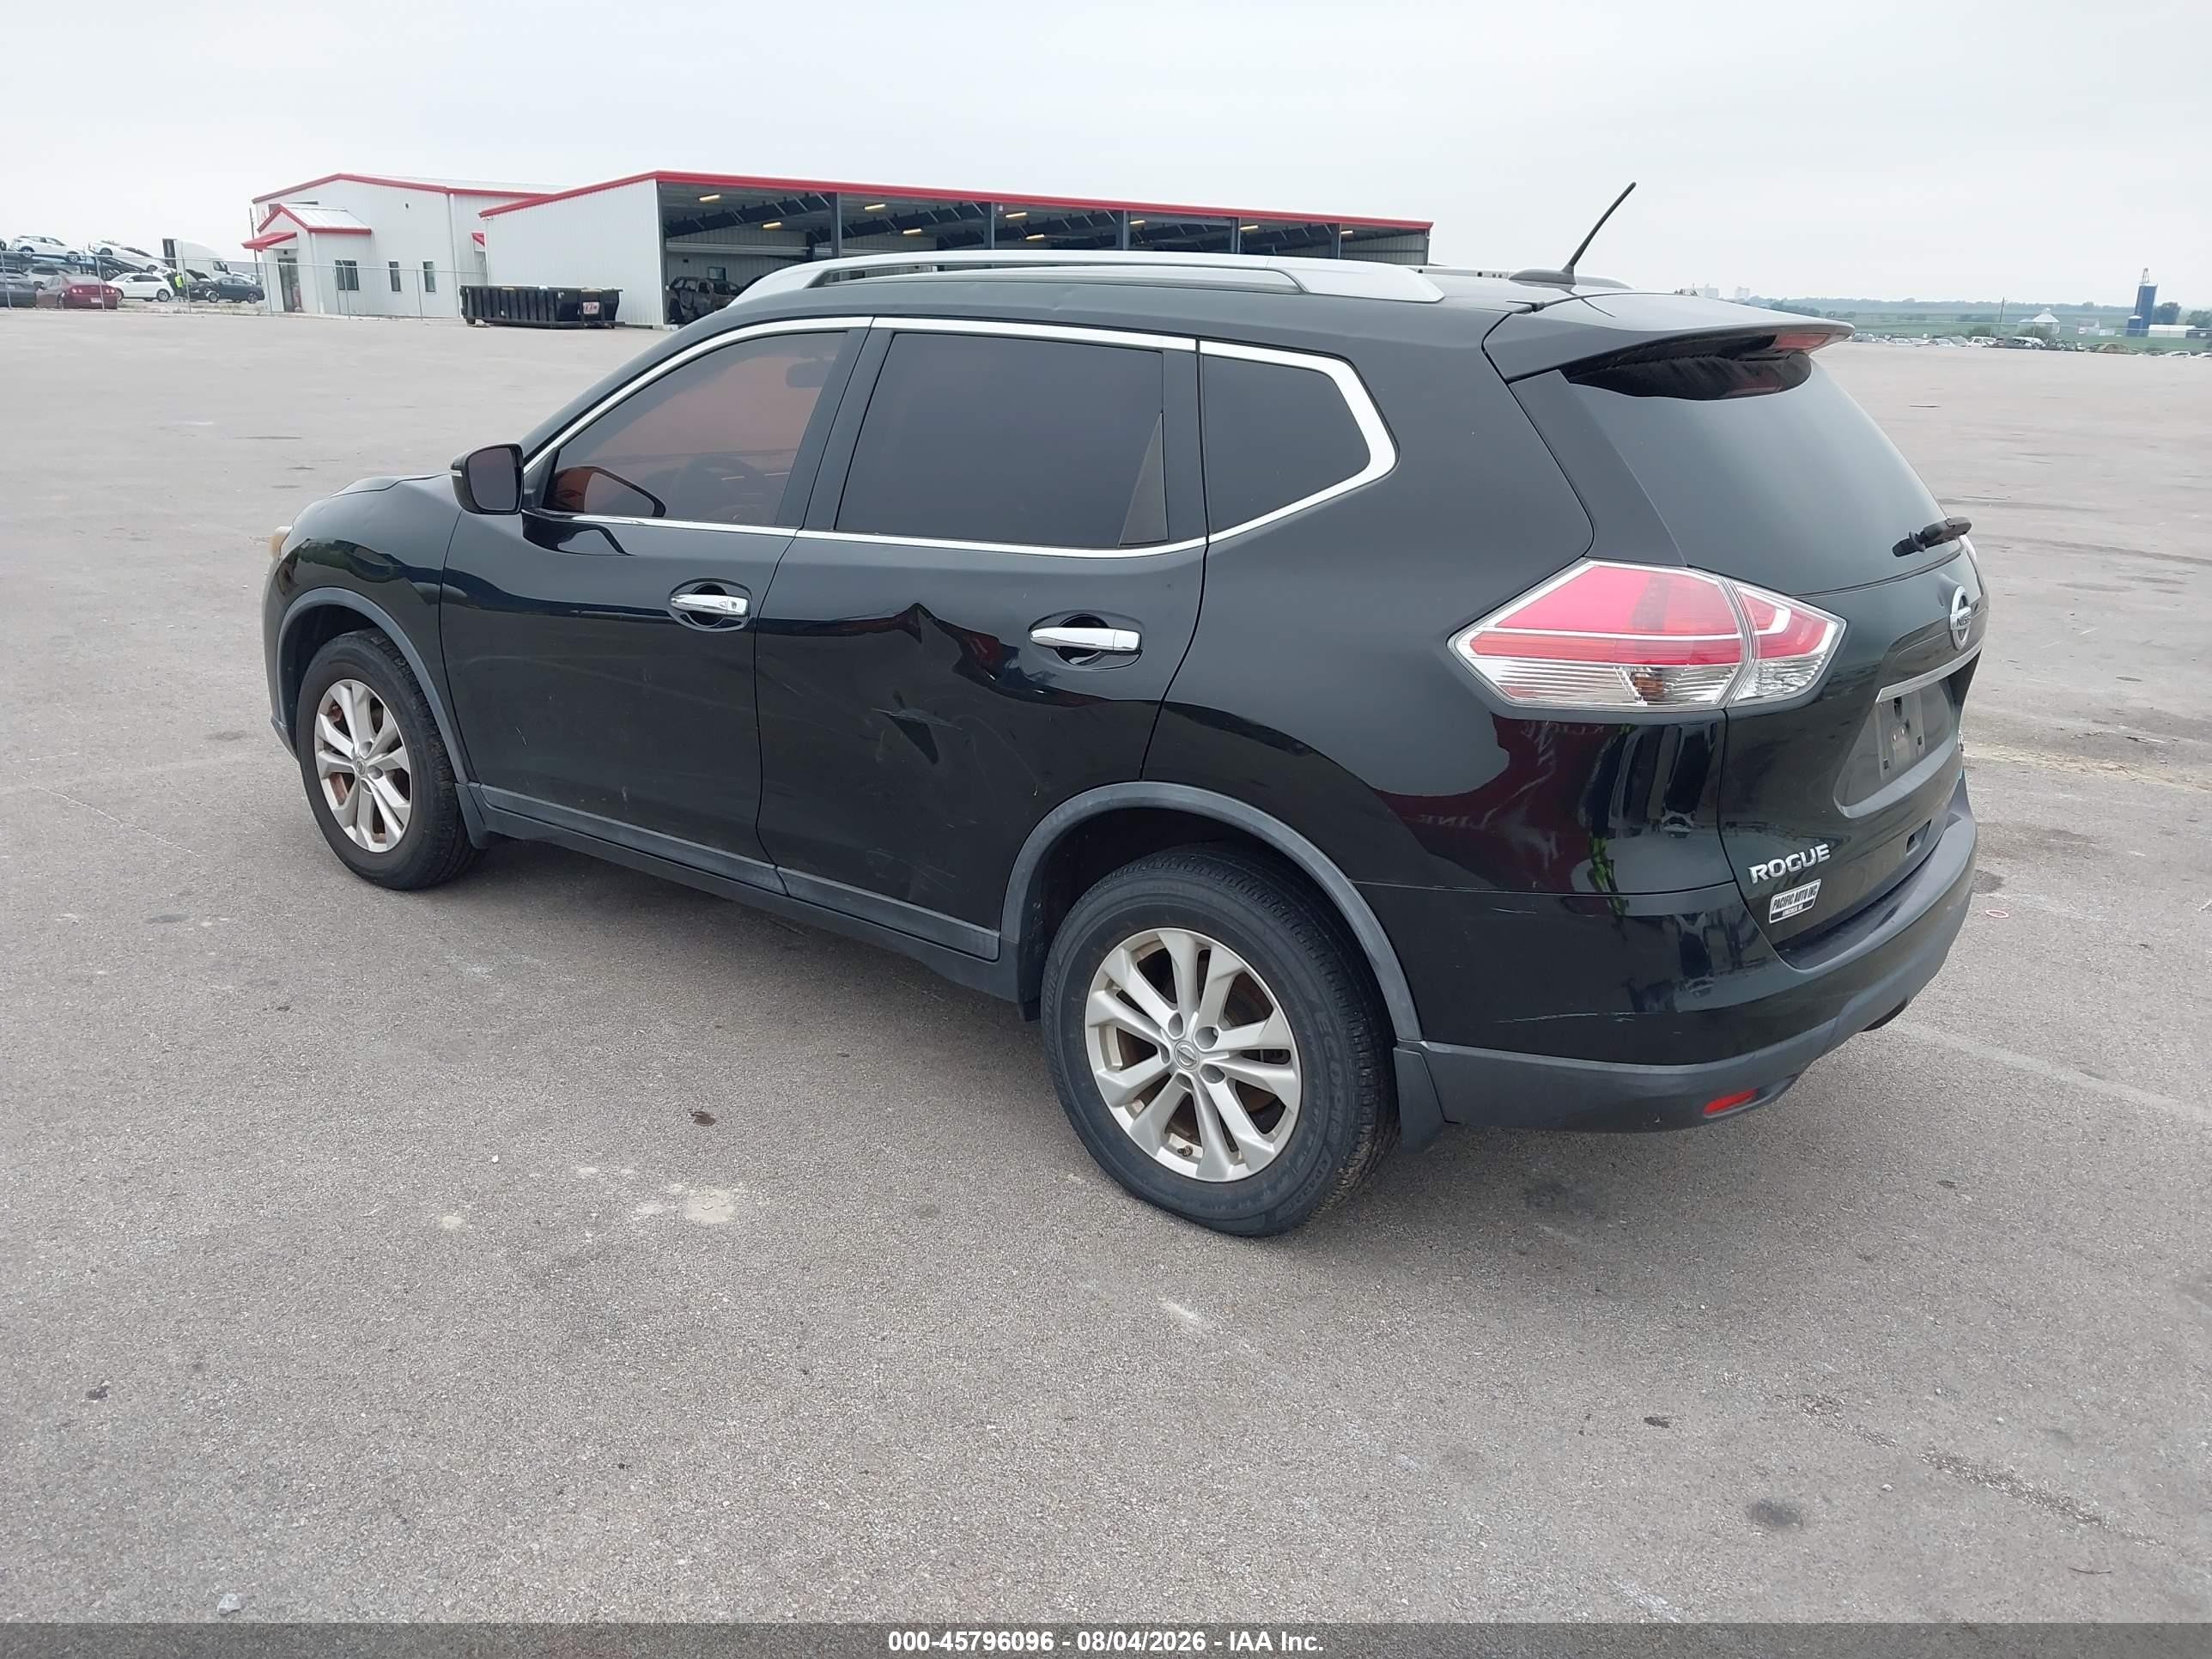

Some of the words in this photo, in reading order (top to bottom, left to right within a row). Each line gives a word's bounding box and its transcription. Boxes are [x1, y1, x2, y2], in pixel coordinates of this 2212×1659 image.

[1747, 843, 1831, 884] ROGUE
[1773, 893, 1795, 910] PACIFIC
[1794, 888, 1808, 903] AUTO
[1808, 884, 1818, 899] INC
